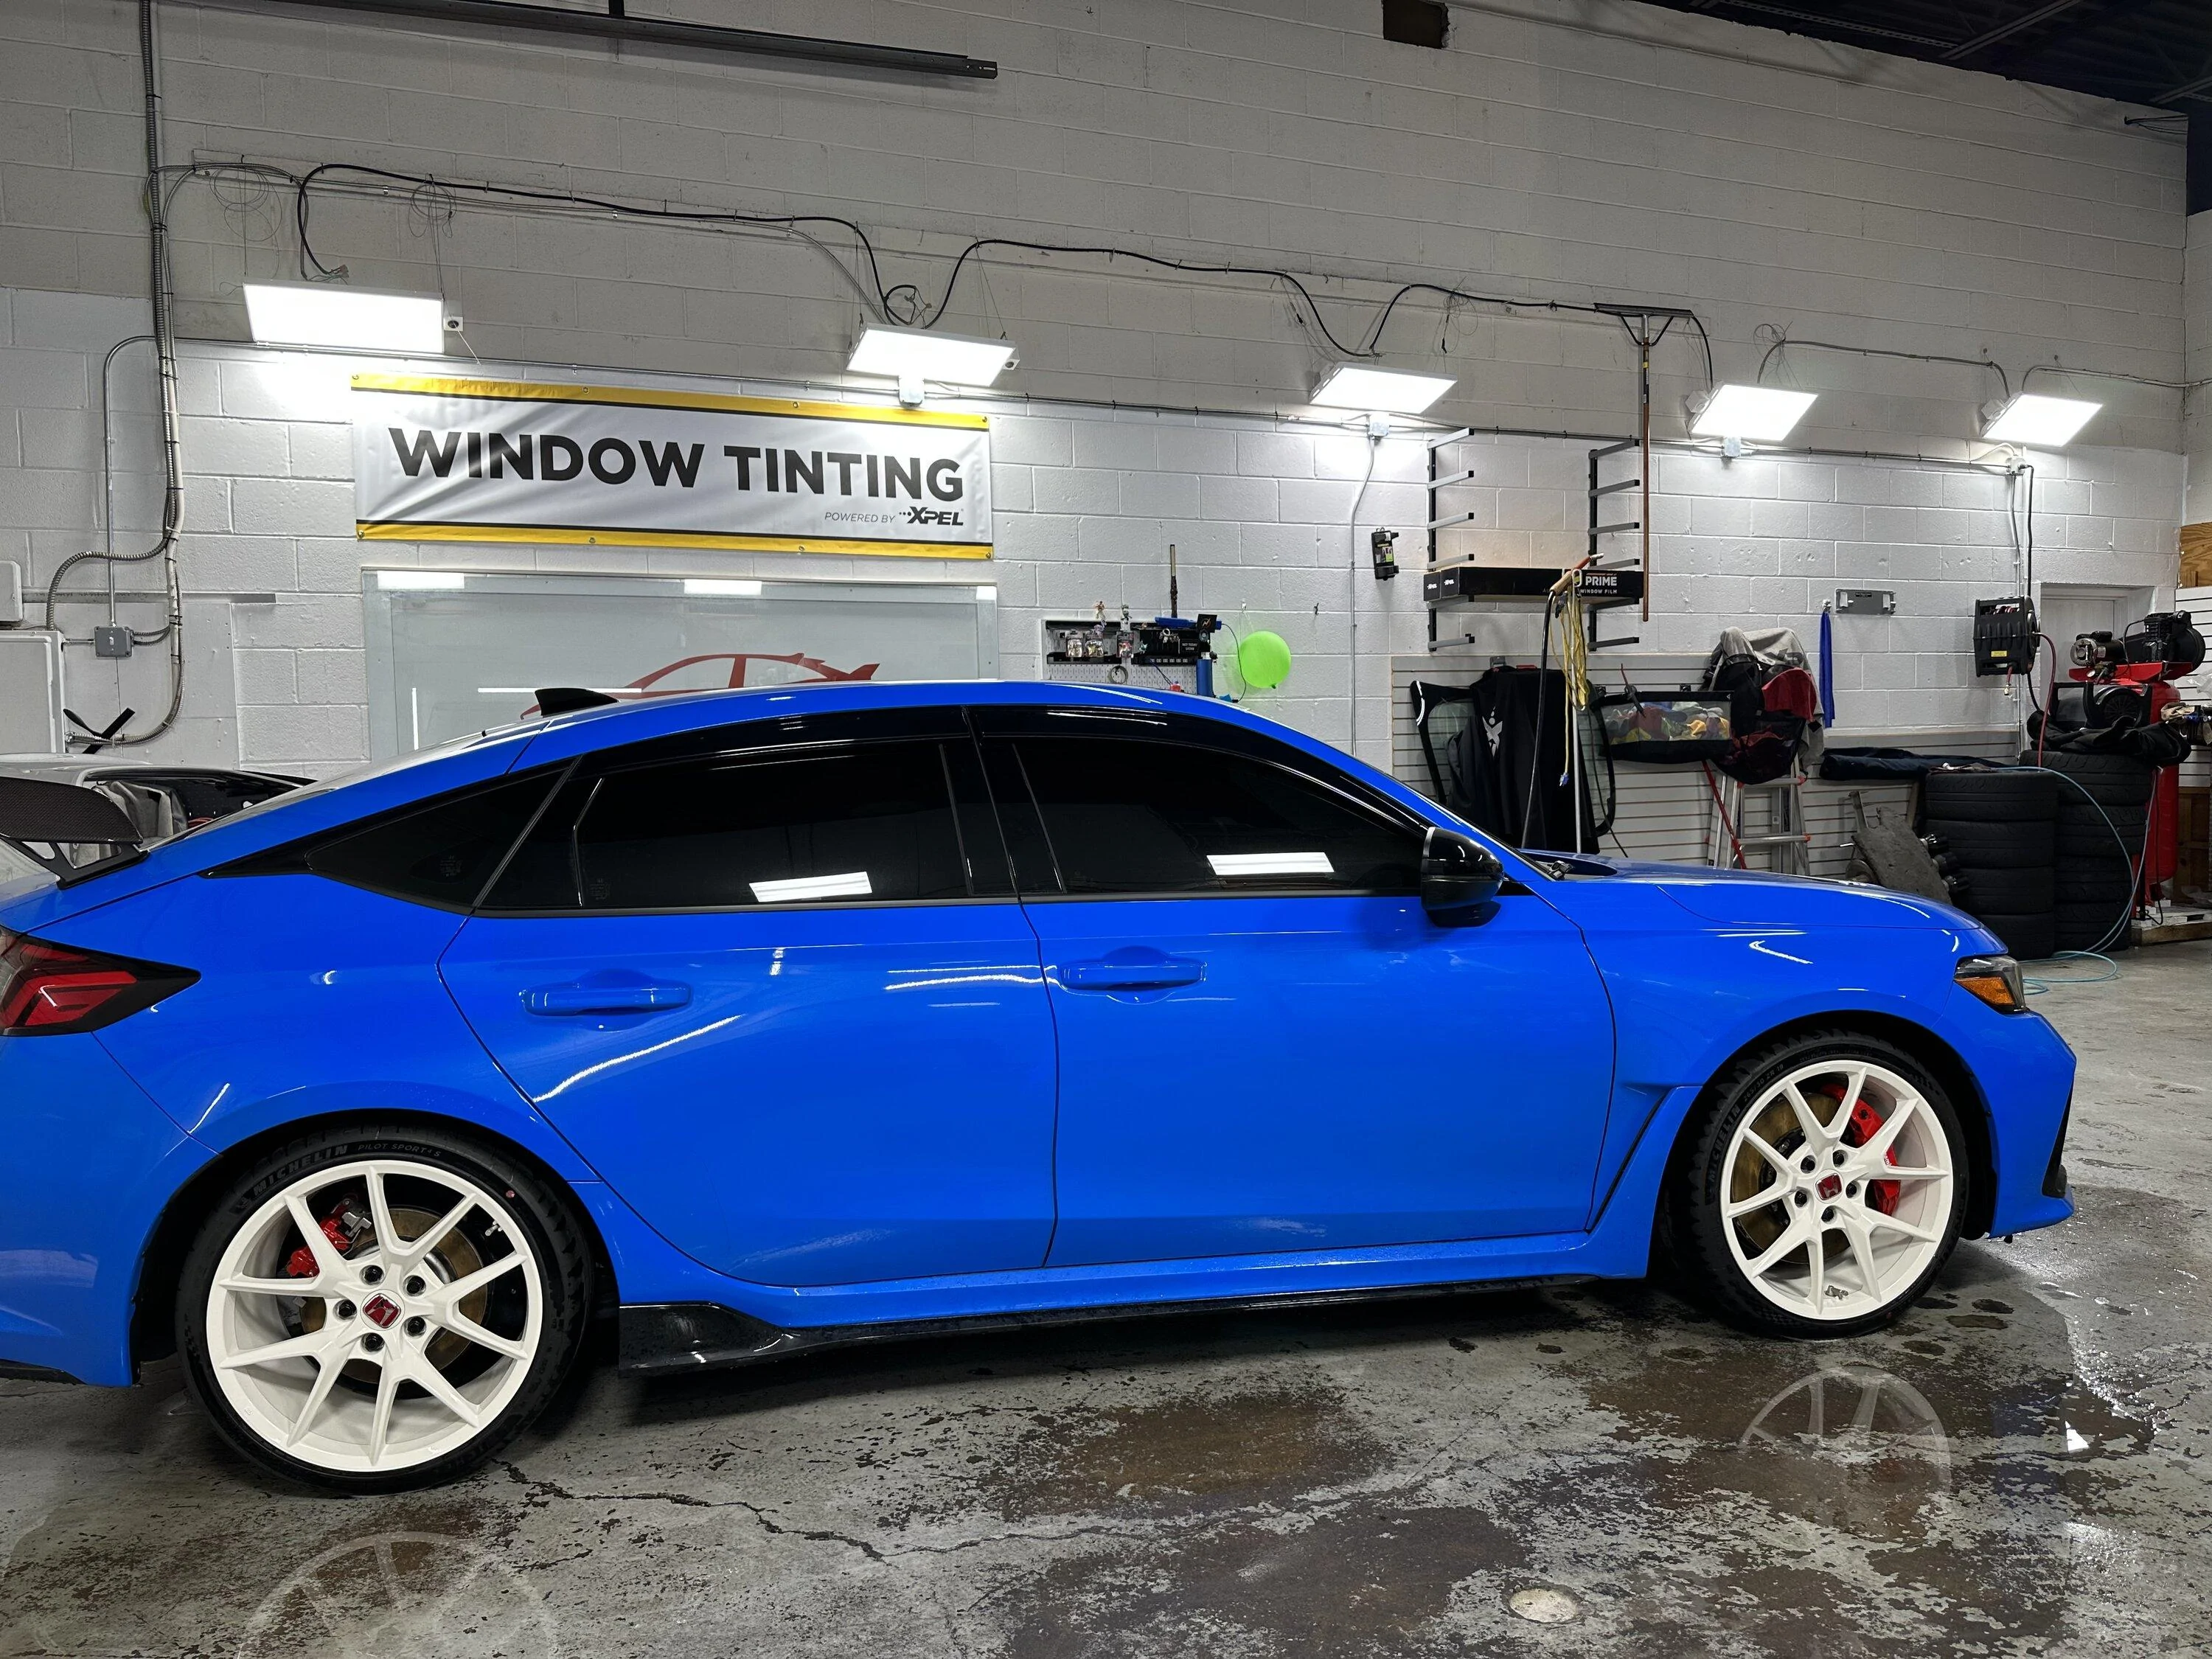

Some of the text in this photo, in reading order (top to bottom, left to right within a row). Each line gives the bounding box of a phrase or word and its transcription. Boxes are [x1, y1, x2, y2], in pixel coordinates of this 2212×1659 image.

[388, 426, 964, 502] WINDOW TINTING
[824, 506, 964, 526] POWERED BY XPEL
[1585, 576, 1618, 586] PRIME
[253, 1144, 348, 1197] MICHELIN
[358, 1143, 389, 1151] PILOT
